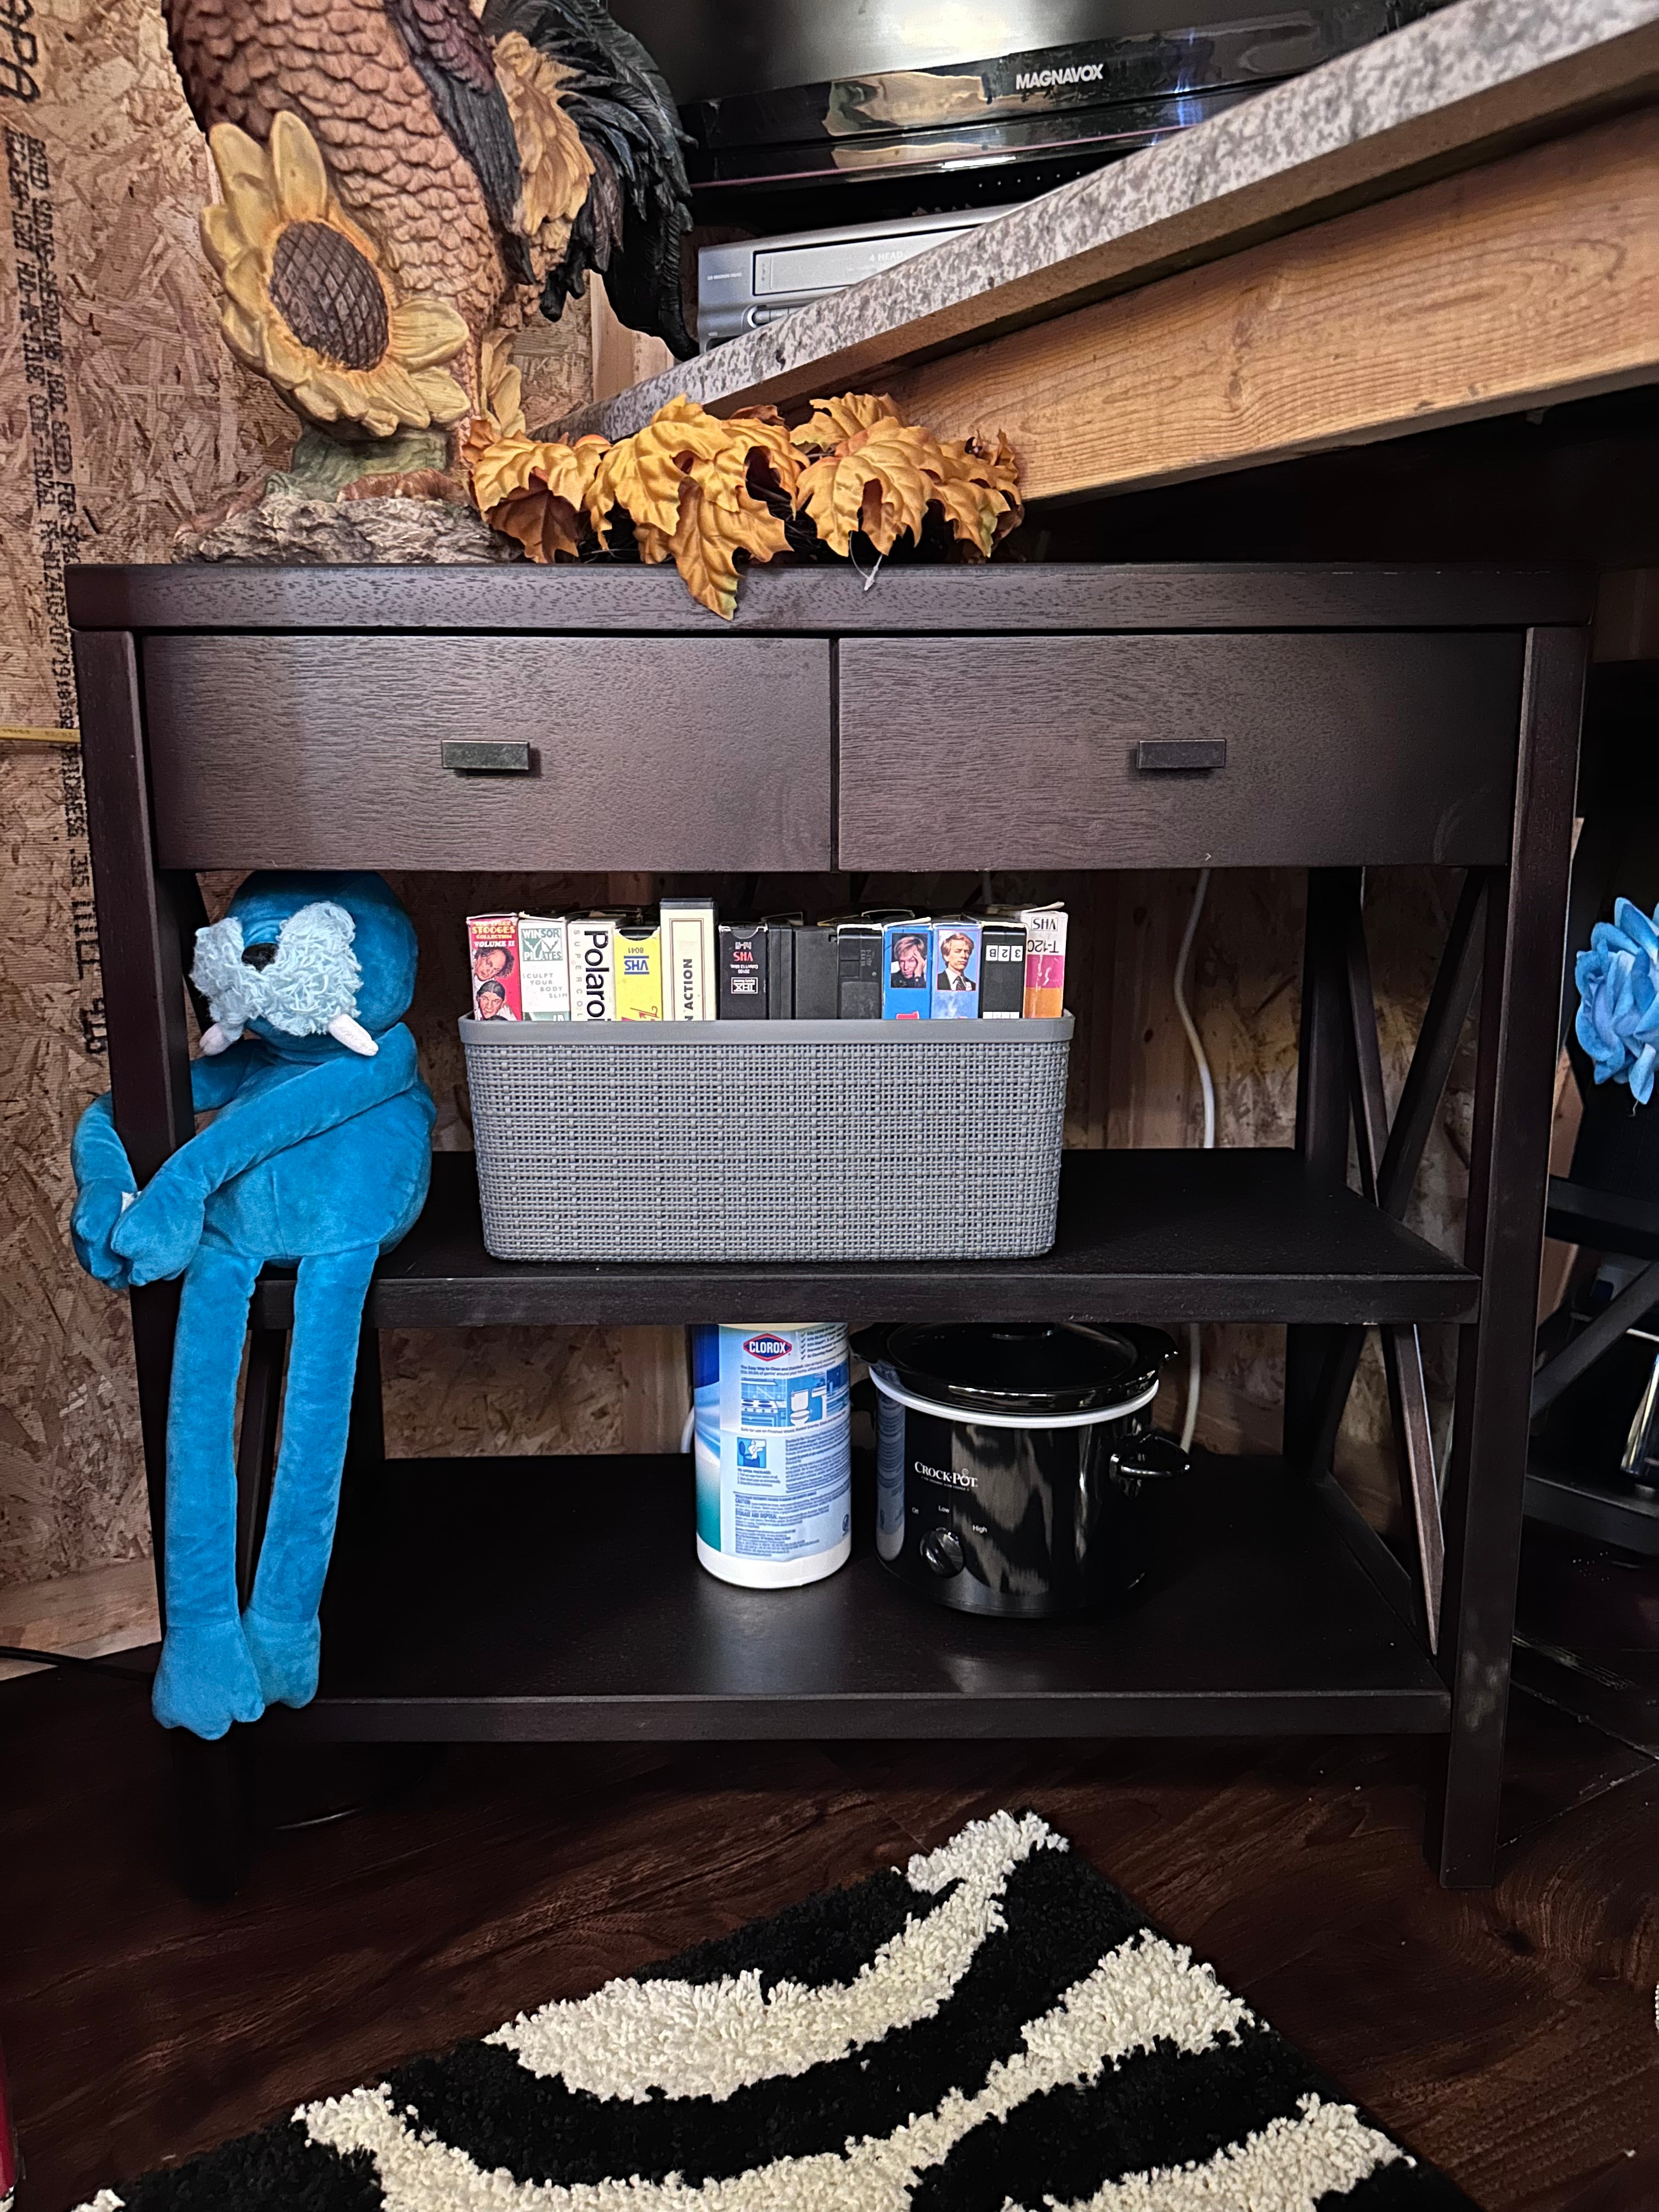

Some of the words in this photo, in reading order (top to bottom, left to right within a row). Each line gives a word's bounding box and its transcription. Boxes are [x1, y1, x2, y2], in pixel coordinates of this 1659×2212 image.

[1016, 64, 1103, 90] MAGNAVOX
[878, 251, 903, 261] HEAD
[1032, 918, 1056, 930] VHS
[522, 929, 560, 939] WINSOR
[1028, 940, 1059, 953] T-120
[524, 951, 562, 961] PILATES
[733, 951, 753, 961] VHS
[624, 960, 649, 970] VHS
[683, 958, 693, 1010] ACTION
[733, 983, 755, 992] THX
[749, 1341, 786, 1353] CLOROX
[938, 1505, 950, 1514] Low
[972, 1525, 988, 1533] High
